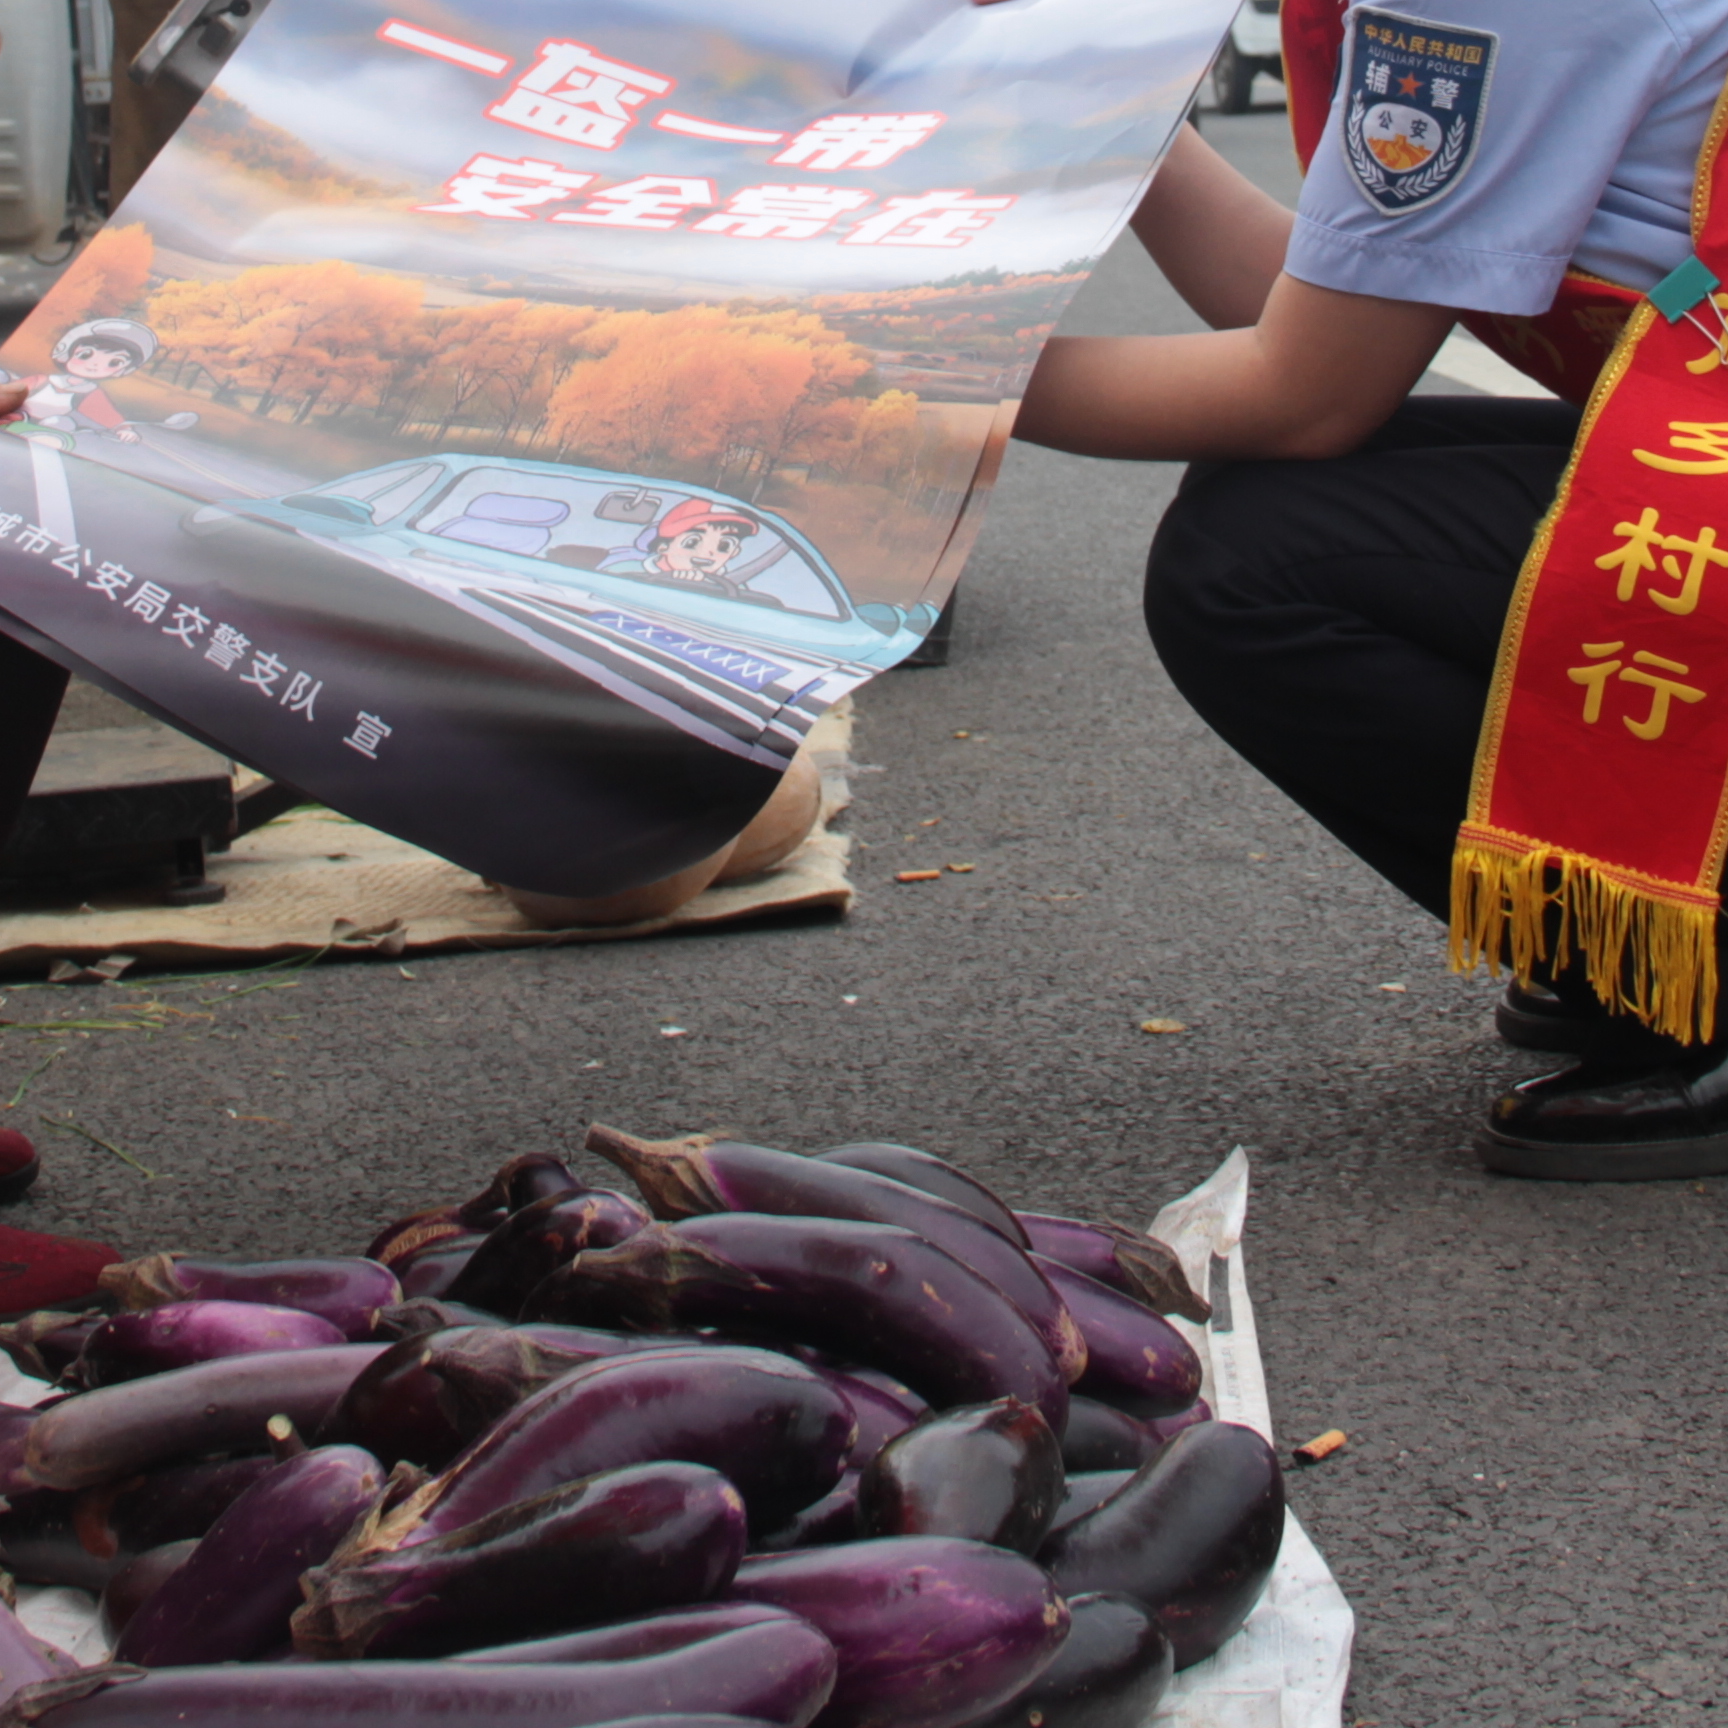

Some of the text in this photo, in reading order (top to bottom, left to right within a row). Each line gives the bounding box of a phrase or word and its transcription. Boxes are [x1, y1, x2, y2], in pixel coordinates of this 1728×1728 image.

[1364, 23, 1483, 65] 中华人民共和国
[1367, 45, 1470, 77] AUXILIARY POLICE
[376, 16, 948, 170] 一盔一带
[1365, 59, 1460, 110] 辅 警
[1378, 110, 1428, 140] 公 安
[408, 151, 1021, 249] 安全常在
[342, 709, 393, 760] 宣
